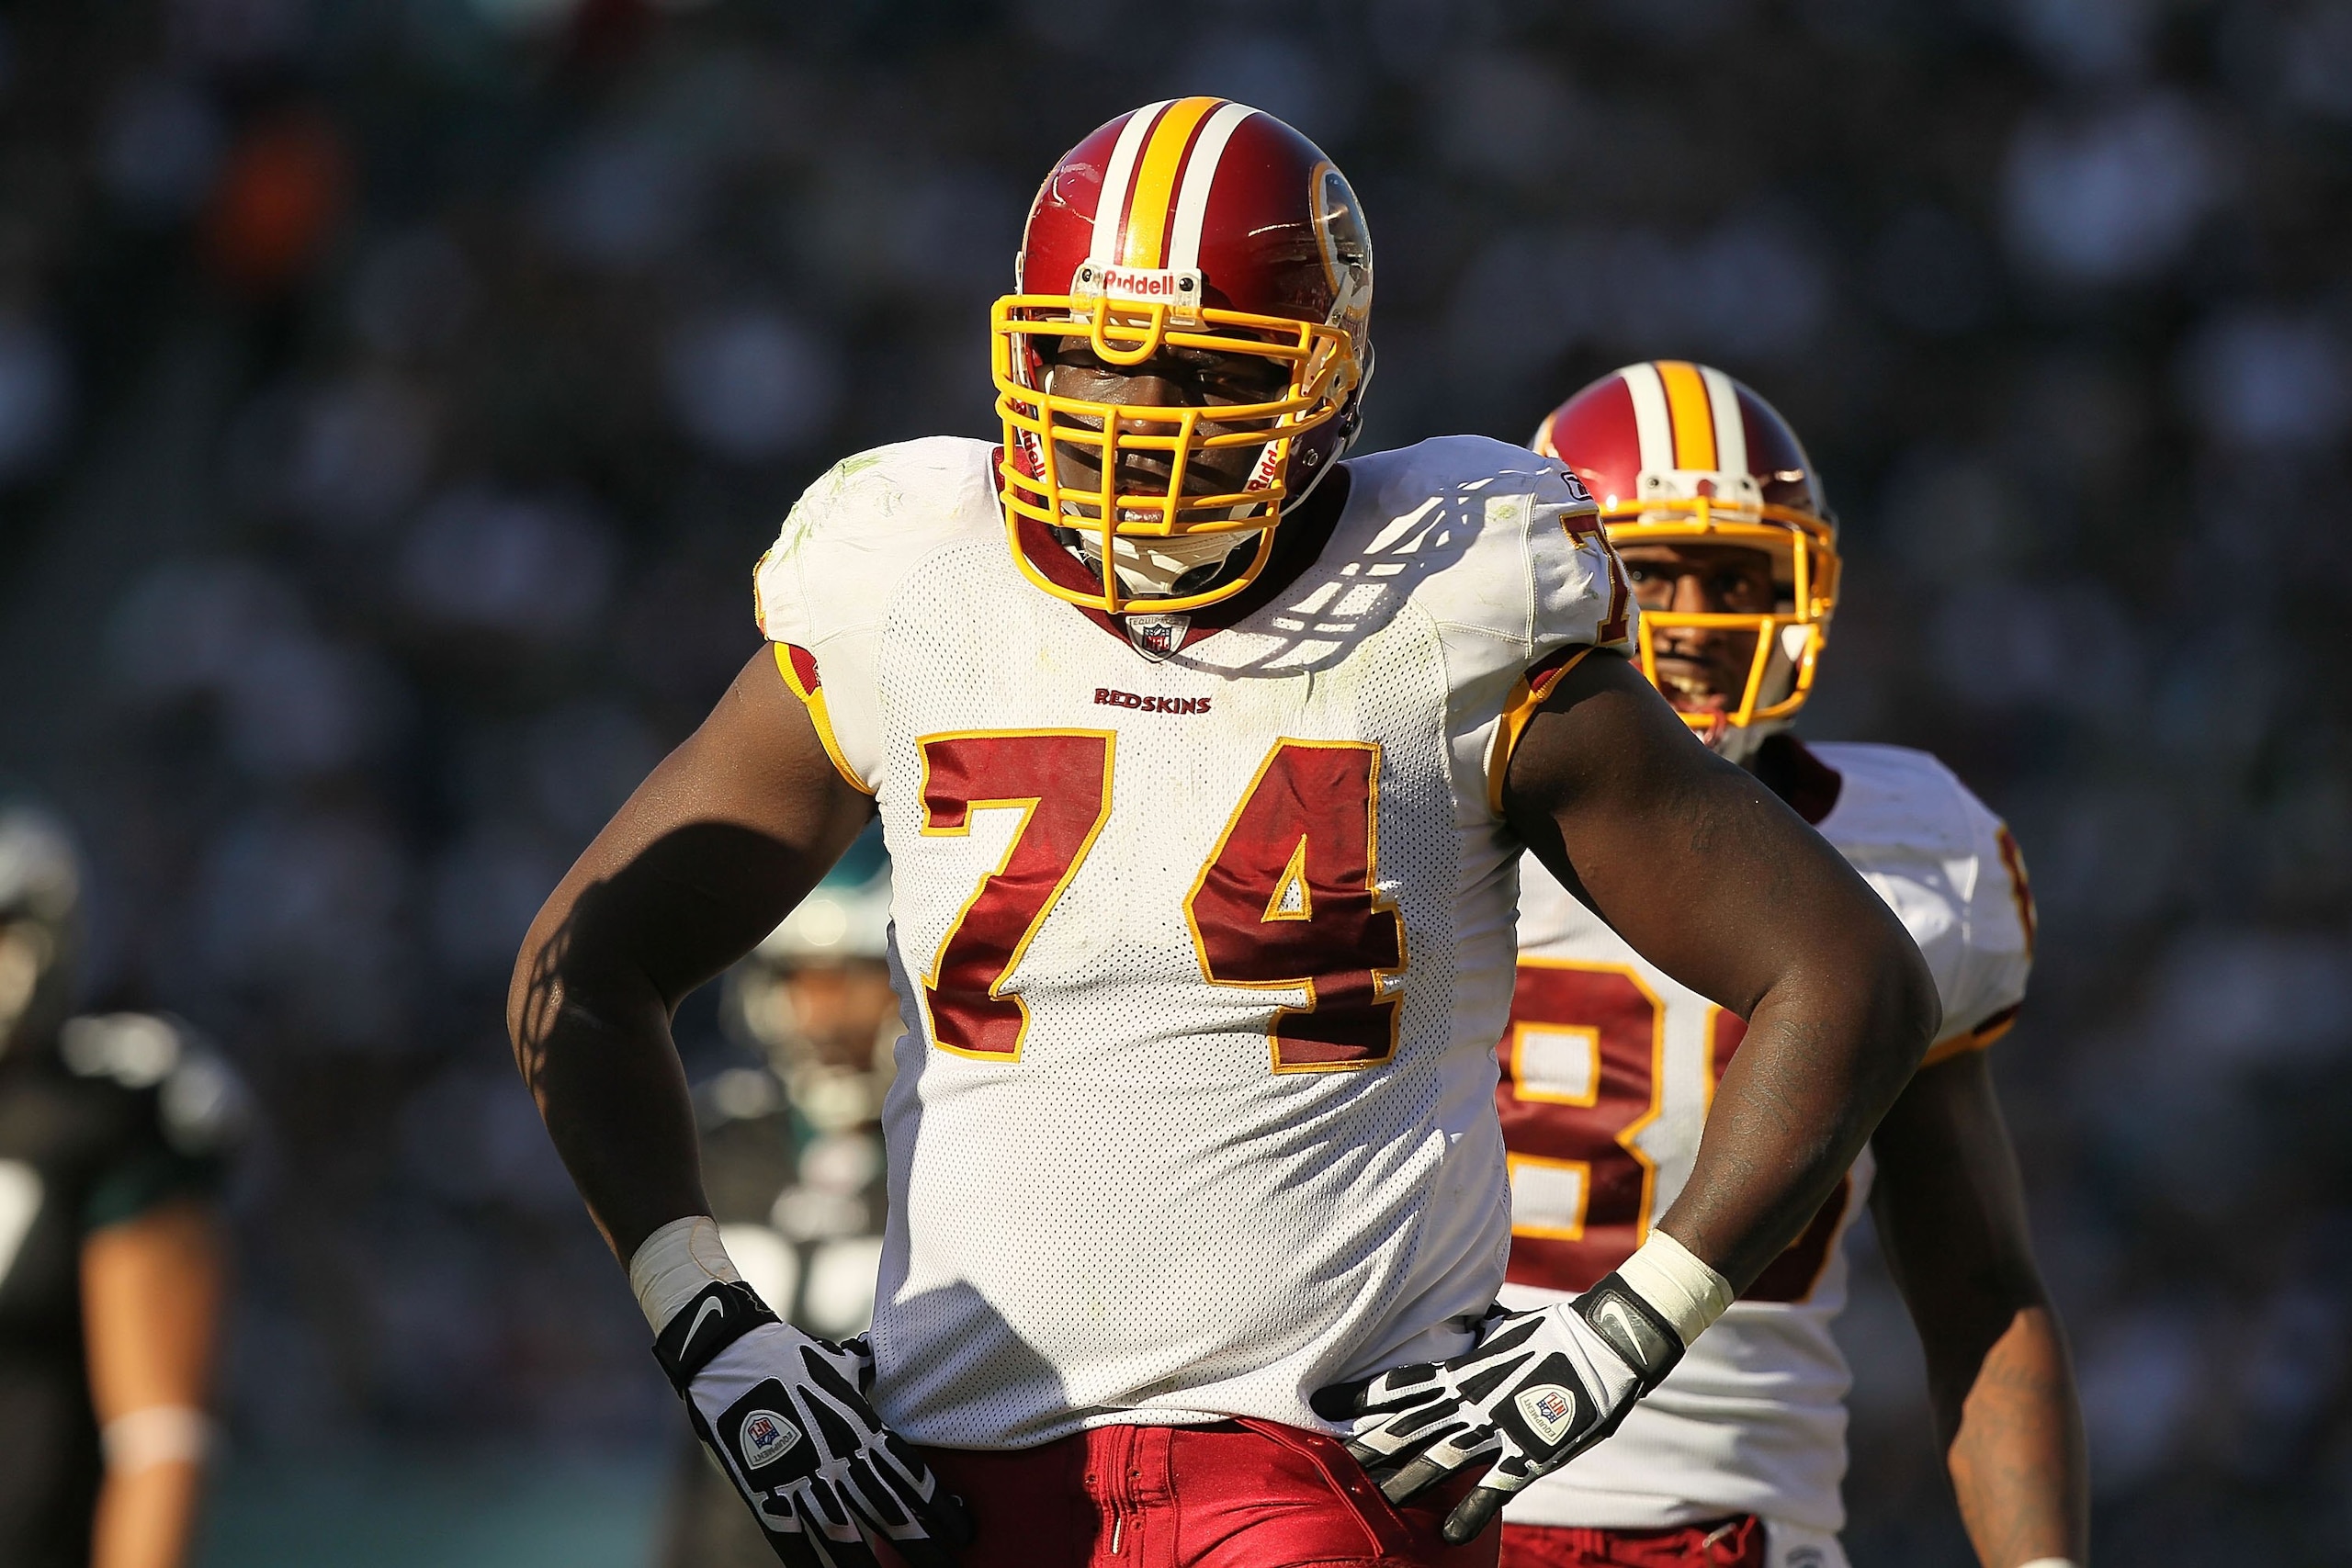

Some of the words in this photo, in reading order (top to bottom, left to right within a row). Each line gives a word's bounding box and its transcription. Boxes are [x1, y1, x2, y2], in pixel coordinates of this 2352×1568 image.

[1103, 270, 1173, 295] Riddell
[1094, 689, 1212, 715] REDSKINS
[915, 728, 1409, 1074] 74
[1547, 1393, 1566, 1416] NFL
[750, 1419, 772, 1438] NFL
[1524, 1398, 1556, 1438] EQUIPMENT
[753, 1431, 794, 1462] EQUIPMENT
